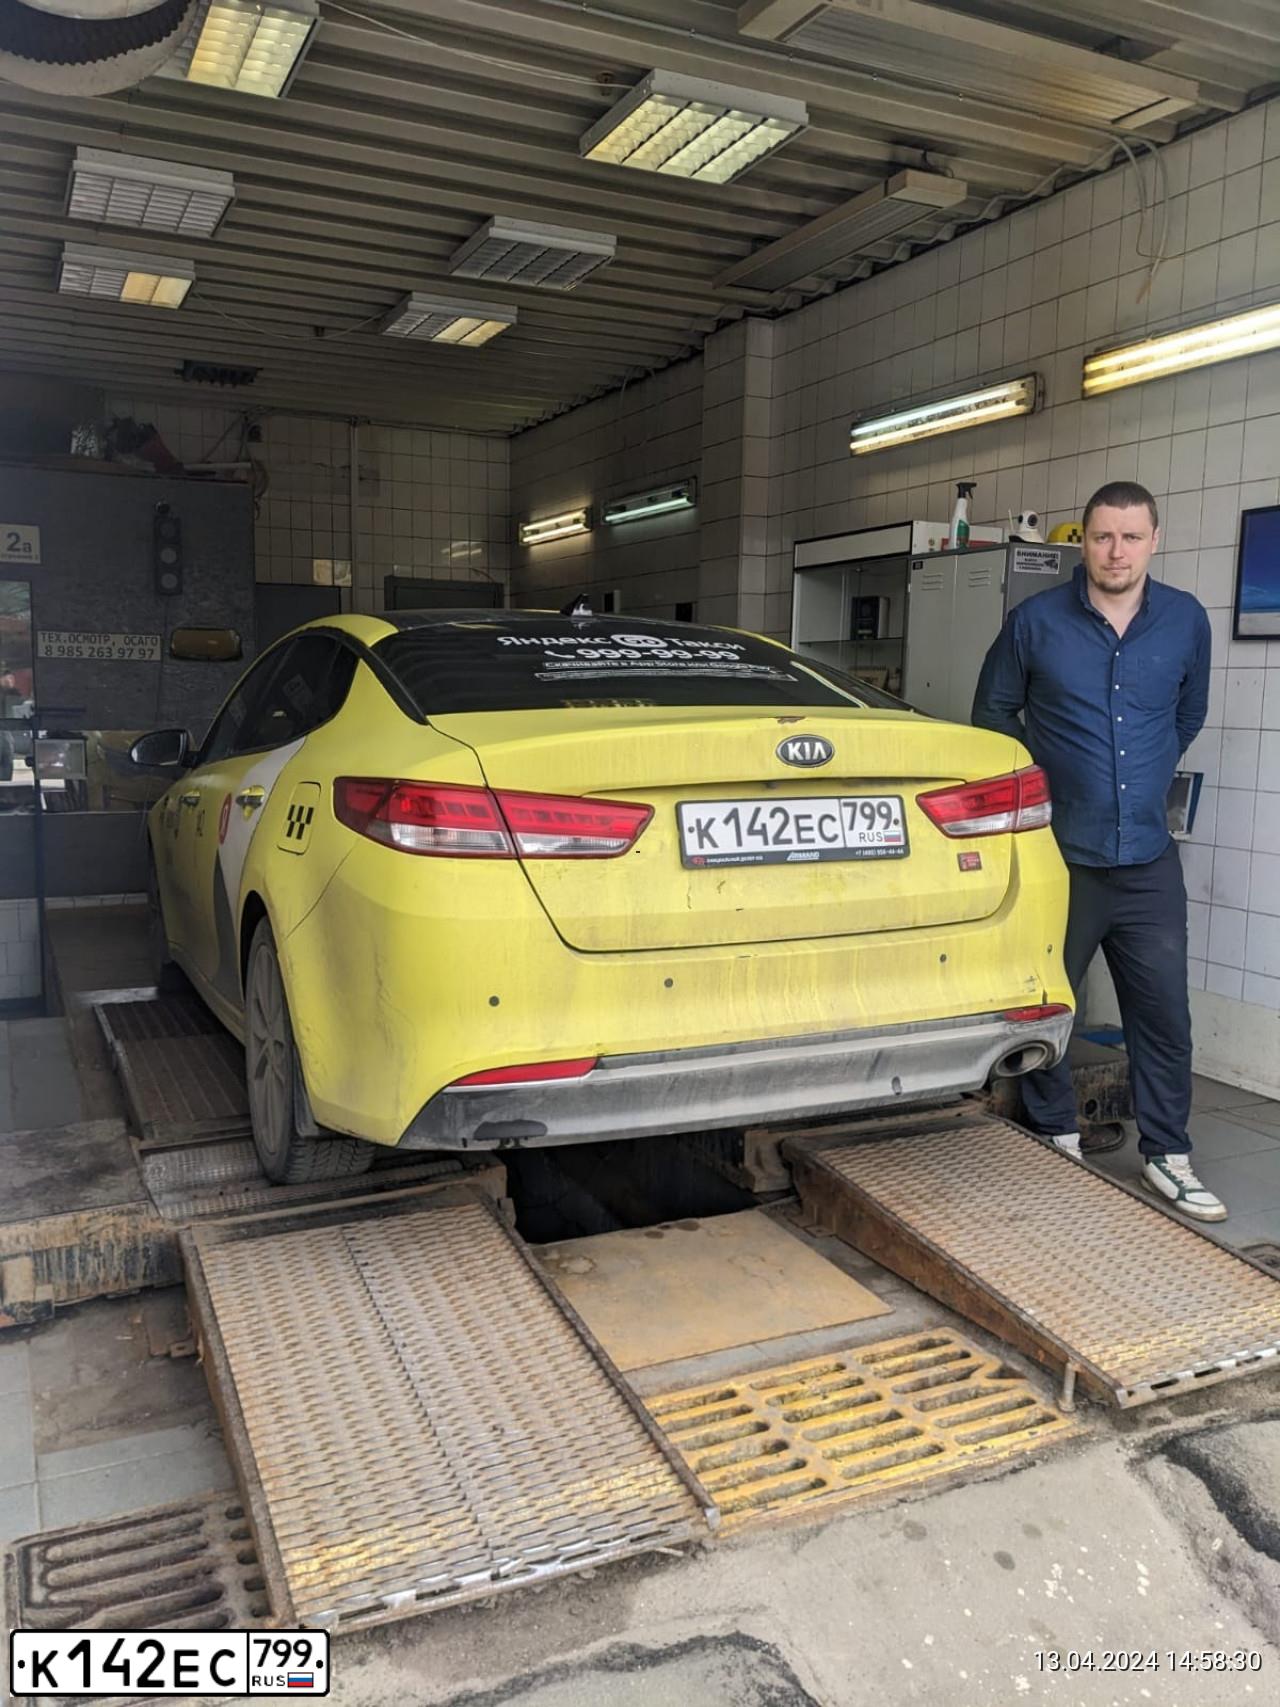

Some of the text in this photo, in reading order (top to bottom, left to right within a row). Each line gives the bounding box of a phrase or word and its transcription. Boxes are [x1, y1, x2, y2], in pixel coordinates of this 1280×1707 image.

[41, 633, 158, 647] ТЕХ.ОСМОТР, ОСАГО
[497, 637, 612, 645] Яндекс
[664, 638, 747, 651] Такси
[45, 646, 154, 659] 8 985 263 97 97
[575, 648, 740, 660] 999-99-99
[787, 742, 827, 761] KIA
[843, 801, 893, 831] 799
[859, 832, 883, 842] RUS
